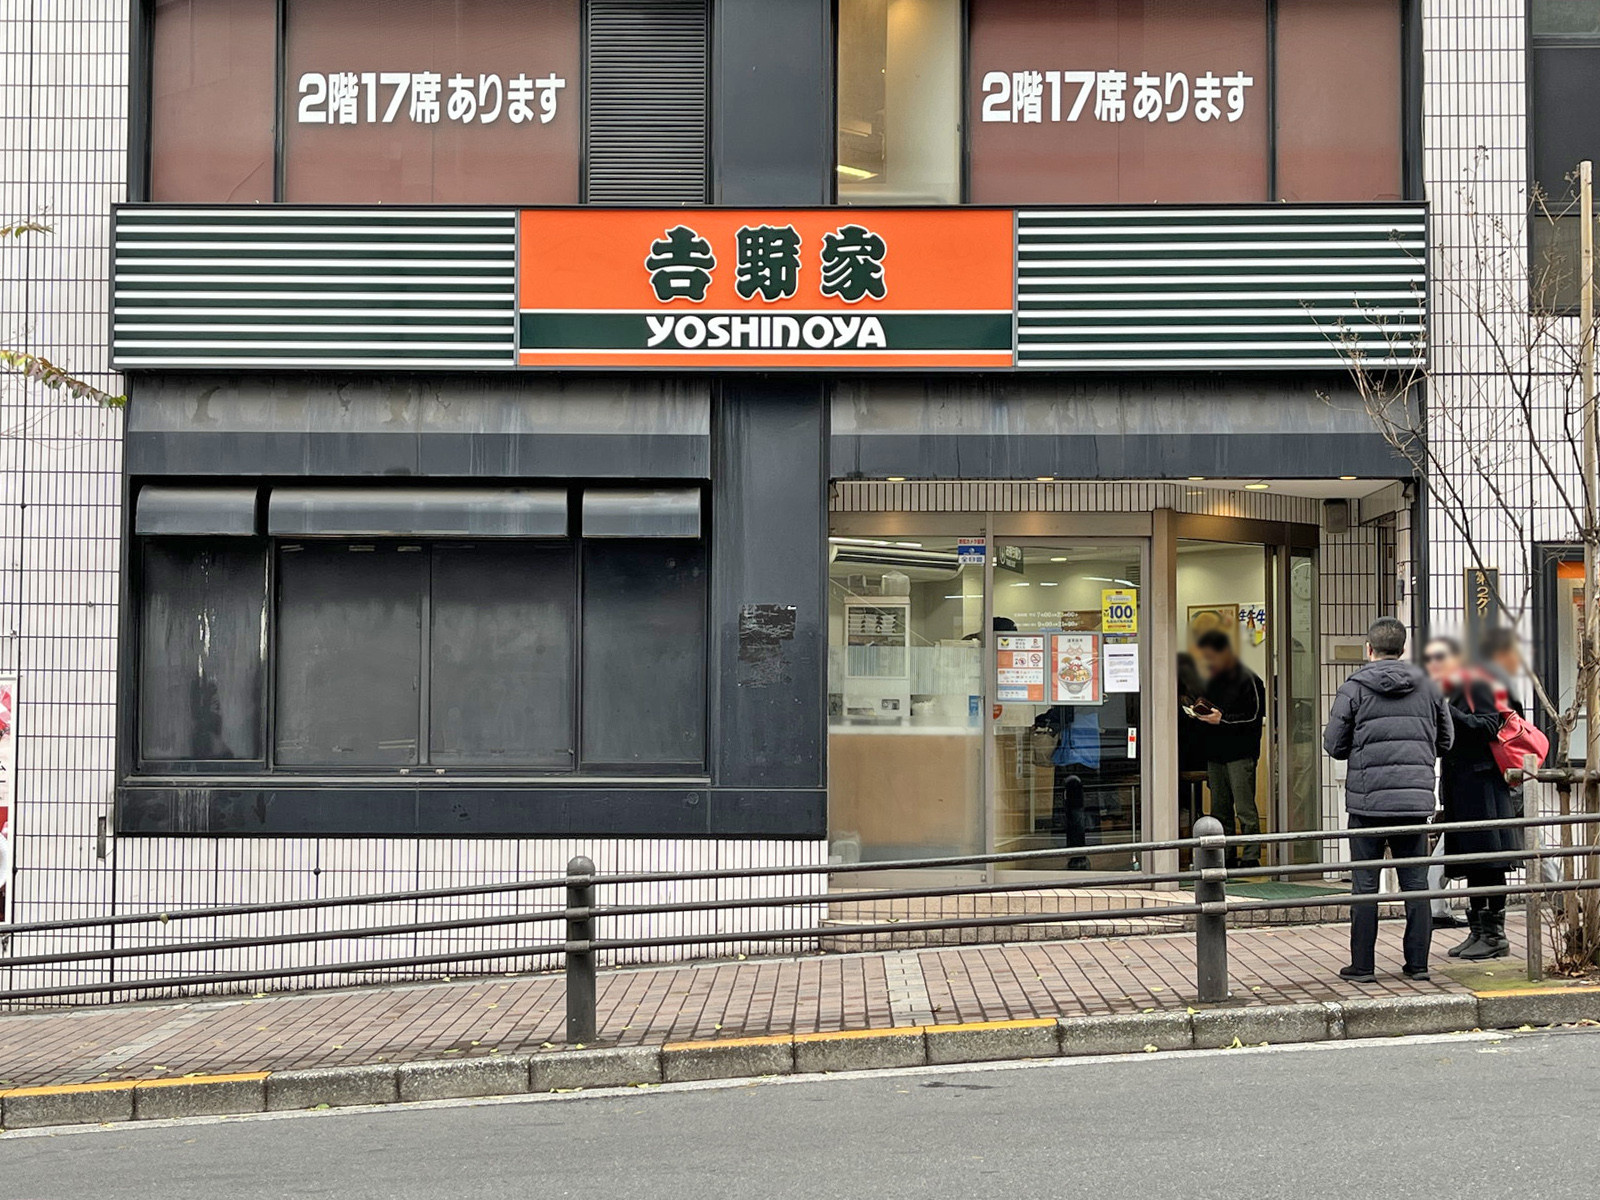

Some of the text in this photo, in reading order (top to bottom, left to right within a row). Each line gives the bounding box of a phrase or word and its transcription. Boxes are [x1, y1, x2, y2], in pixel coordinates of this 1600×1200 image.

[298, 71, 566, 124] 2階17席あります
[982, 70, 1254, 123] 2階17席あります
[645, 224, 888, 303] 吉野家
[646, 315, 887, 348] YOSHINOYA
[1109, 605, 1133, 619] 100
